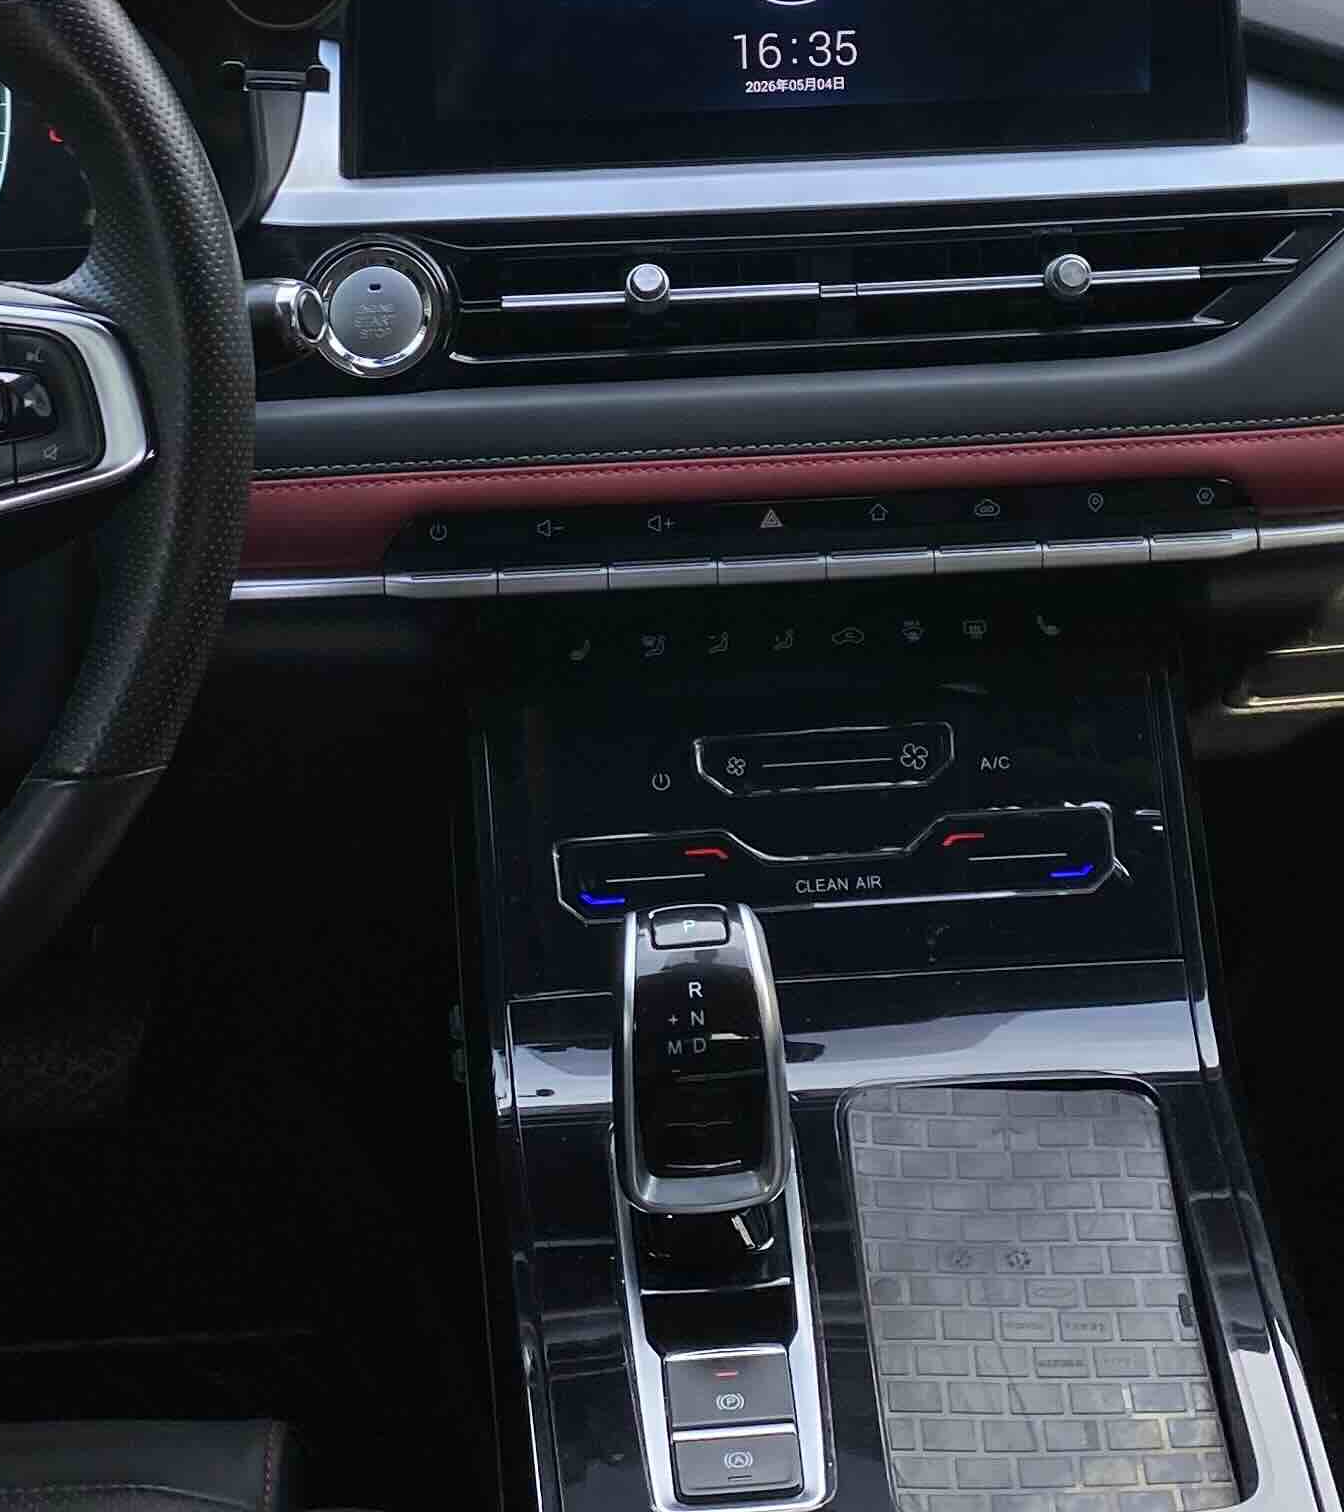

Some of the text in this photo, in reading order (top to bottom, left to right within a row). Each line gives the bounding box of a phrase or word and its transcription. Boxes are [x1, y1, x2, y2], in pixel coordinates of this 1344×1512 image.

[733, 29, 858, 70] 16:35
[745, 76, 845, 94] 2026年05月04日
[980, 756, 1011, 771] A/C
[795, 875, 883, 894] CLEAN AIR
[682, 919, 695, 933] P
[688, 981, 703, 998] R
[690, 1009, 705, 1026] N
[667, 1039, 706, 1055] M D
